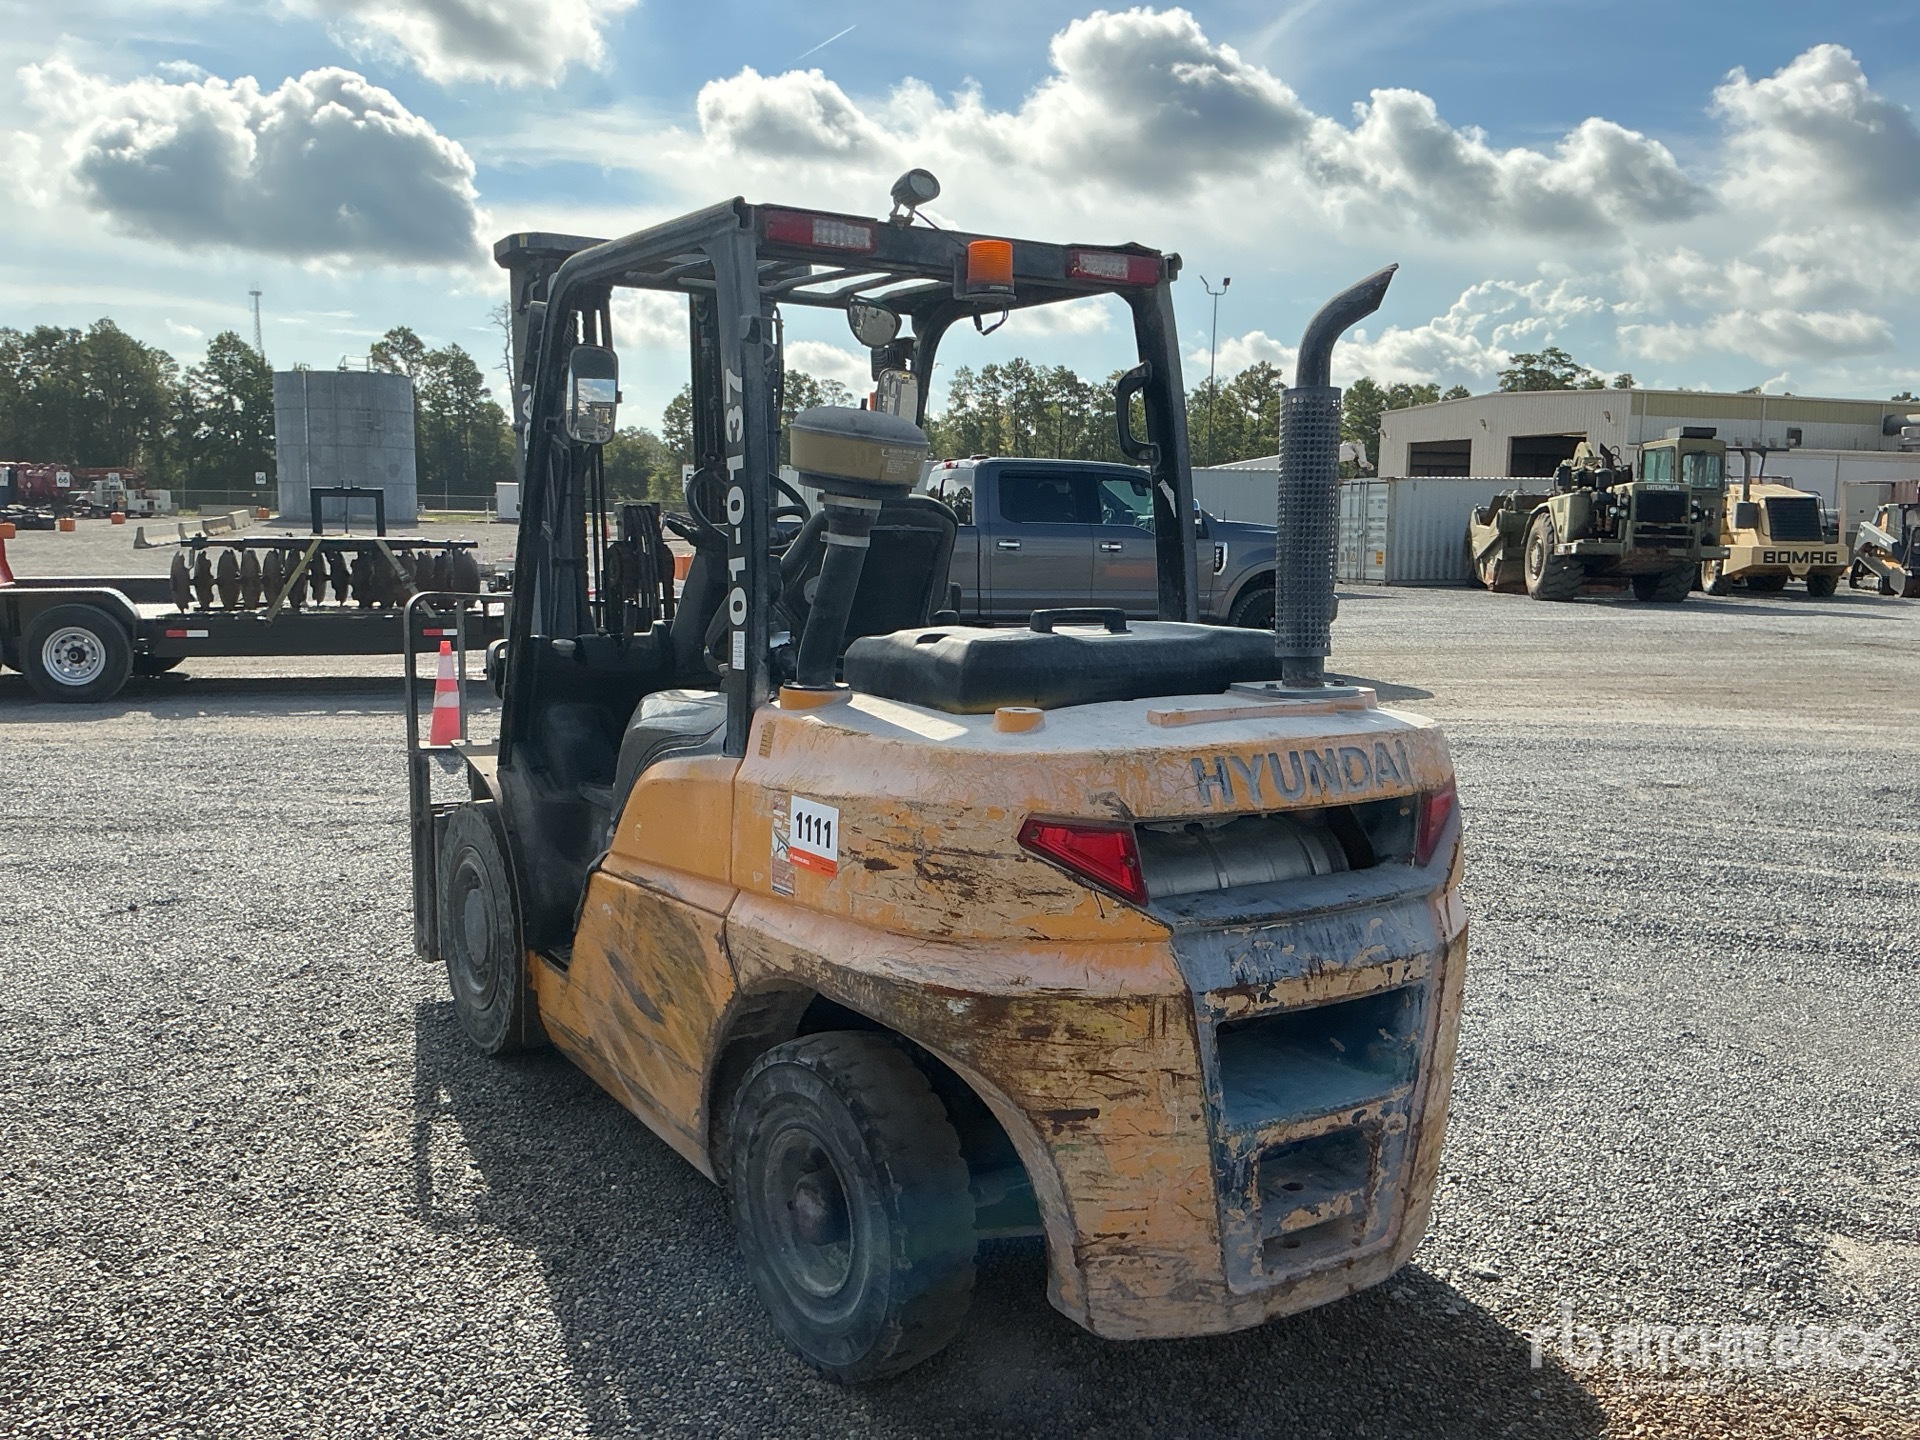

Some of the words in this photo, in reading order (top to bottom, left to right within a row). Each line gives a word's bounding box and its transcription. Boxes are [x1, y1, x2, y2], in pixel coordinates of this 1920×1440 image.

[58, 476, 69, 484] 66
[725, 368, 747, 626] 01-0137
[1763, 551, 1838, 564] BOMAG
[1190, 740, 1413, 808] HYUNDAI
[796, 811, 832, 849] 1111
